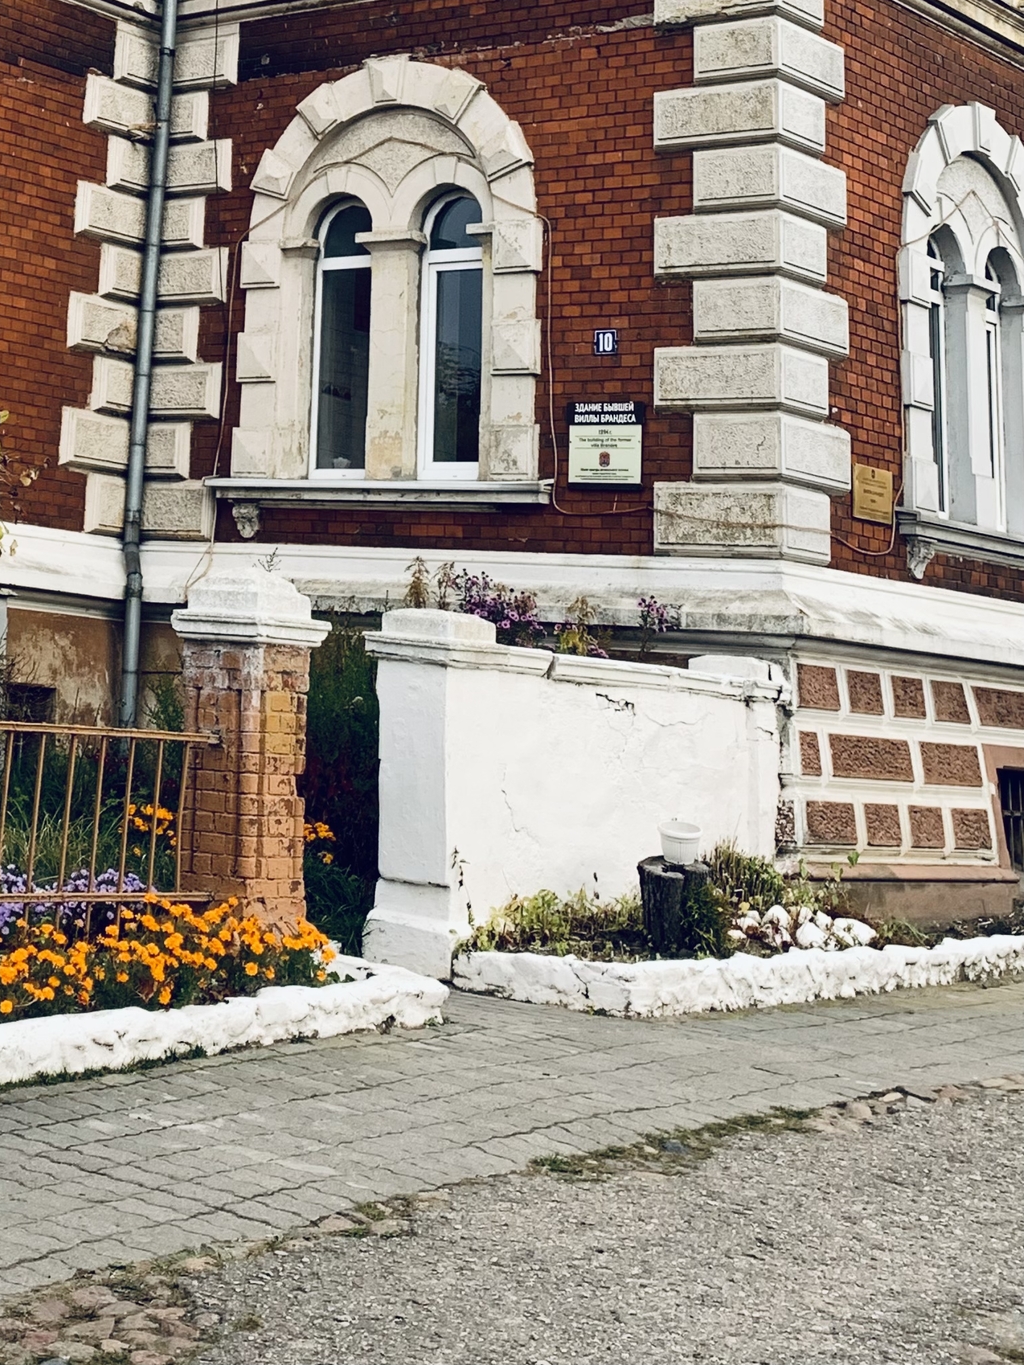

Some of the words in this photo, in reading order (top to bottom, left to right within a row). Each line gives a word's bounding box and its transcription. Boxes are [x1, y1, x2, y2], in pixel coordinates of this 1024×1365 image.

[598, 333, 612, 351] 10
[574, 404, 602, 412] ЗДАНИЕ
[603, 401, 634, 412] БЫВШЕЙ
[574, 414, 600, 423] ВИЛЛЫ
[600, 414, 636, 423] БРАНДЕСА
